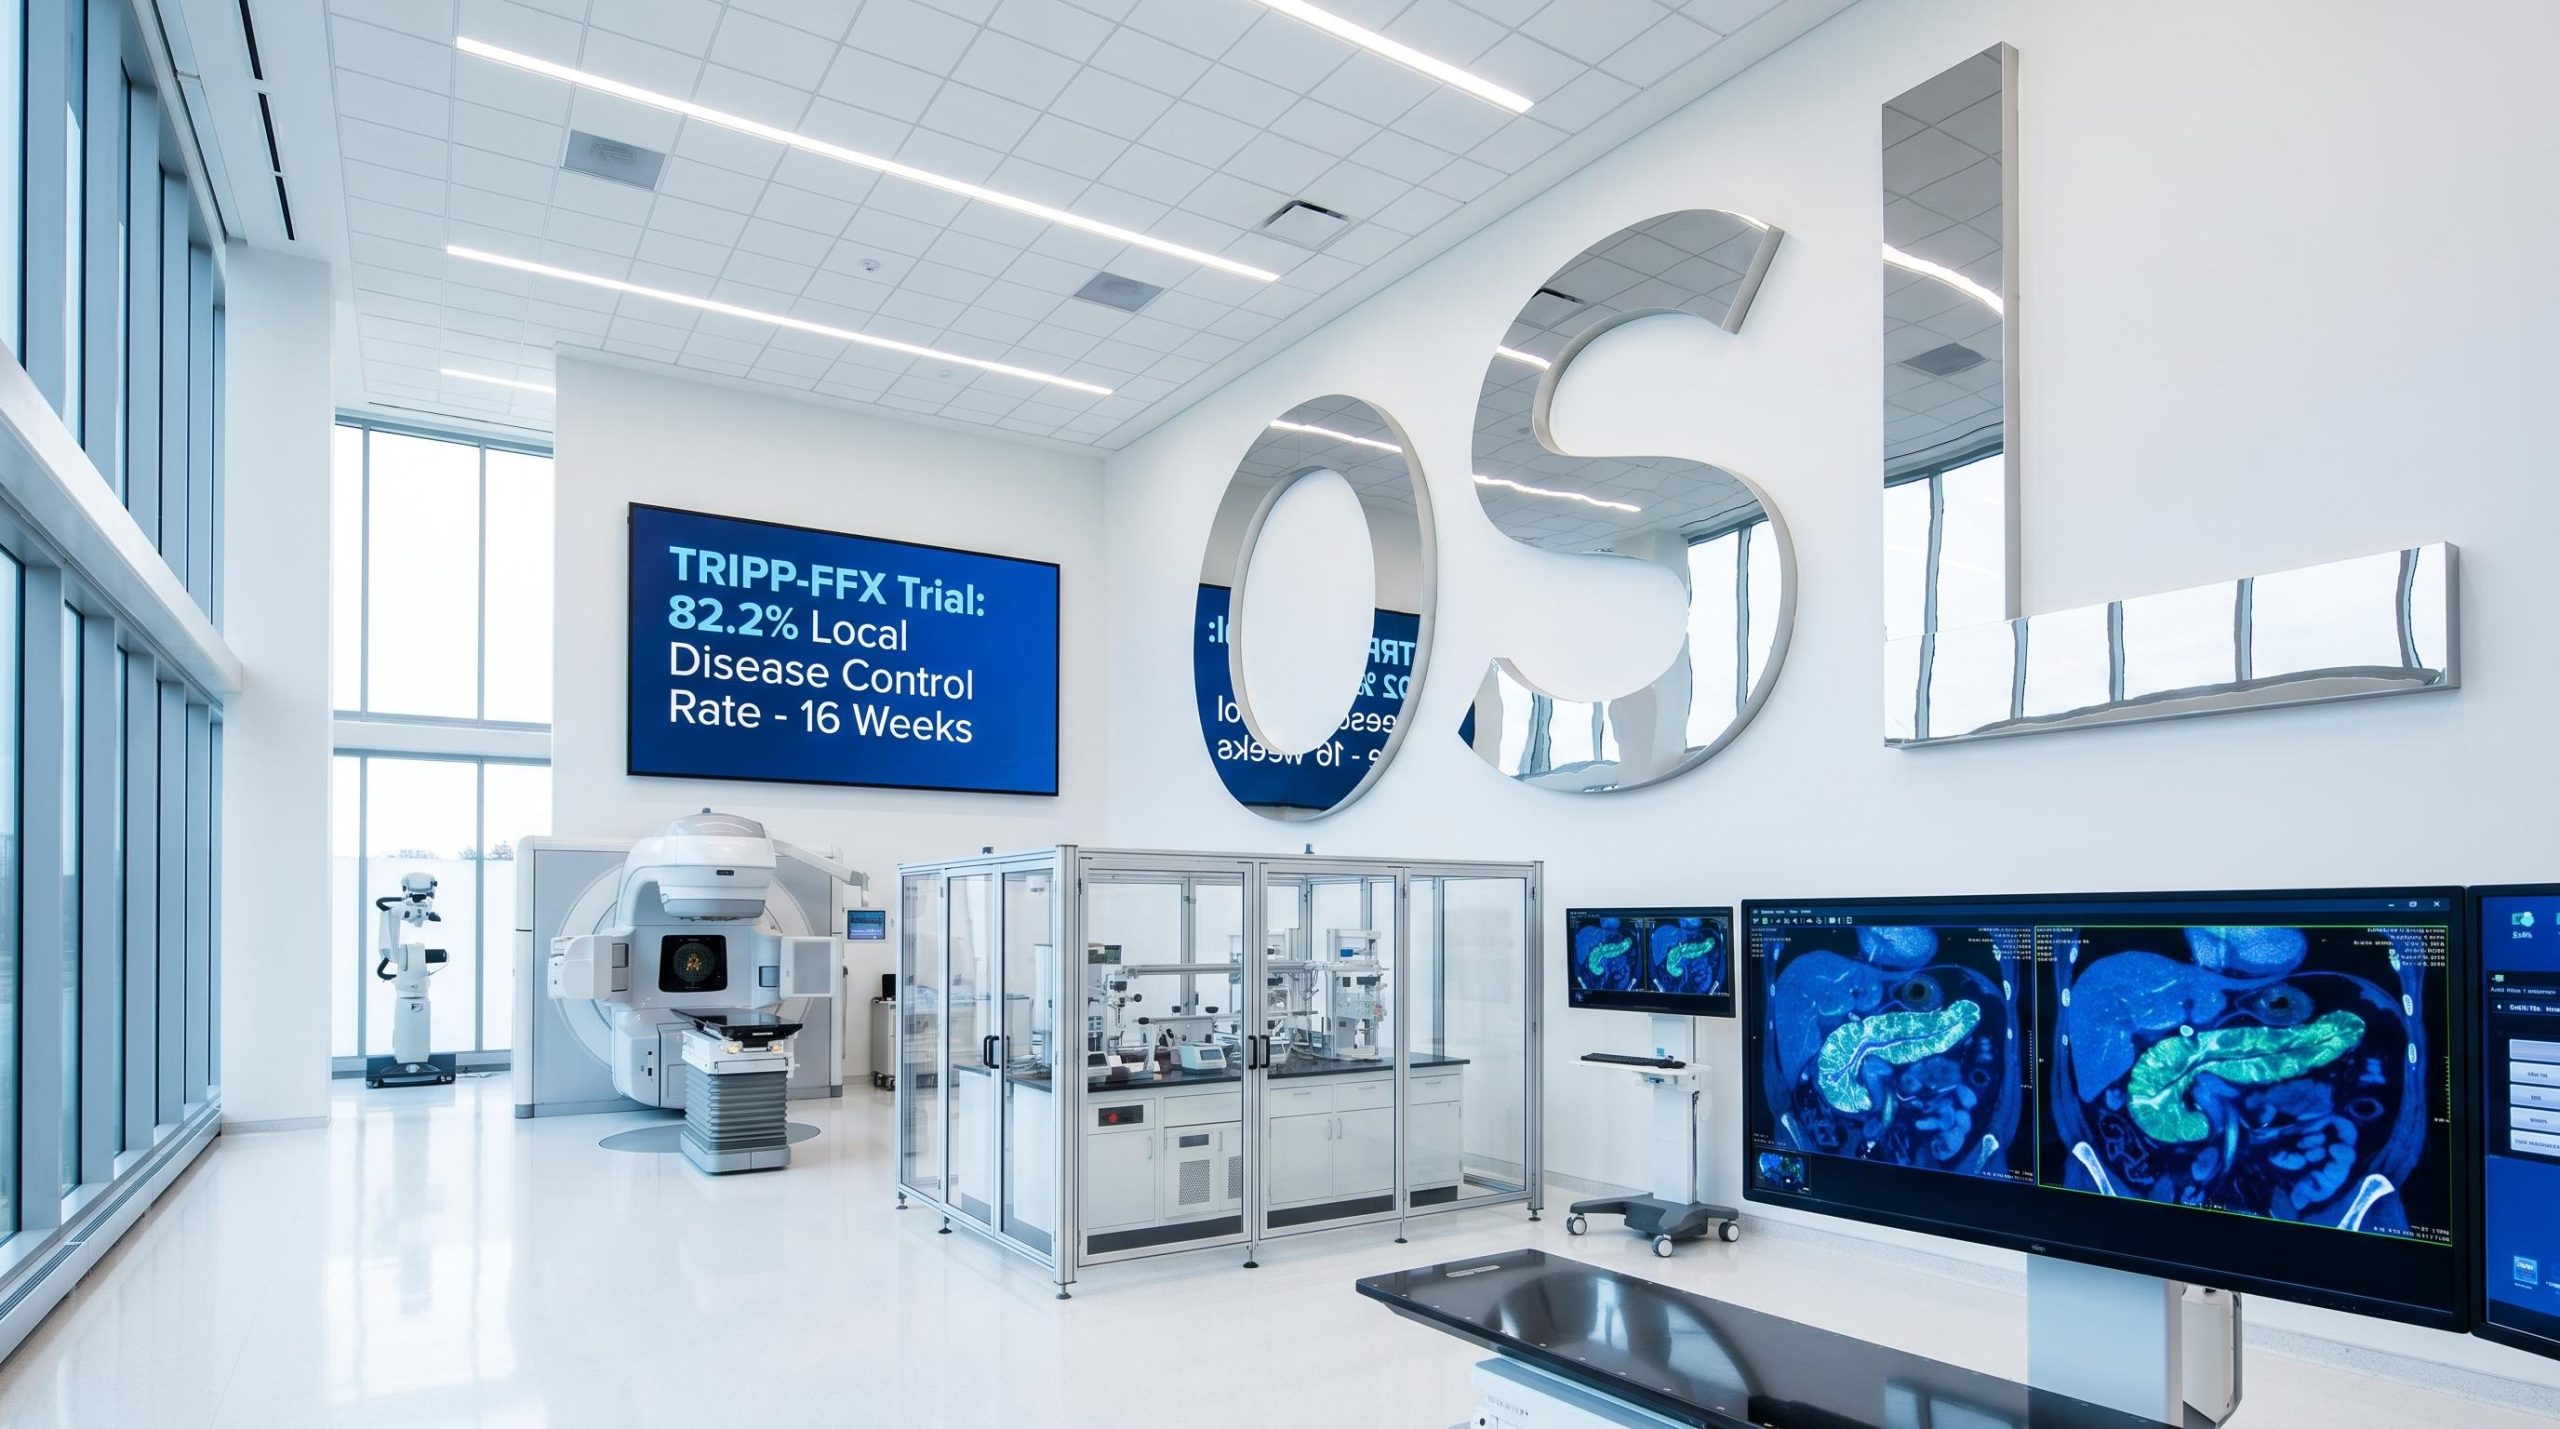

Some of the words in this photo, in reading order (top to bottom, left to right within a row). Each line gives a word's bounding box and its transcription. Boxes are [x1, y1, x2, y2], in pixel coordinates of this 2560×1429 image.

[1193, 42, 2461, 822] OSL
[669, 545, 887, 605] TRIPP-FFX
[897, 574, 985, 617] Trial:
[668, 594, 799, 640] 82.2%
[812, 609, 907, 652] Local
[670, 641, 830, 689] Disease
[842, 658, 973, 701] Control
[670, 688, 762, 729] Rate
[800, 699, 841, 735] 16
[852, 702, 973, 744] Weeks
